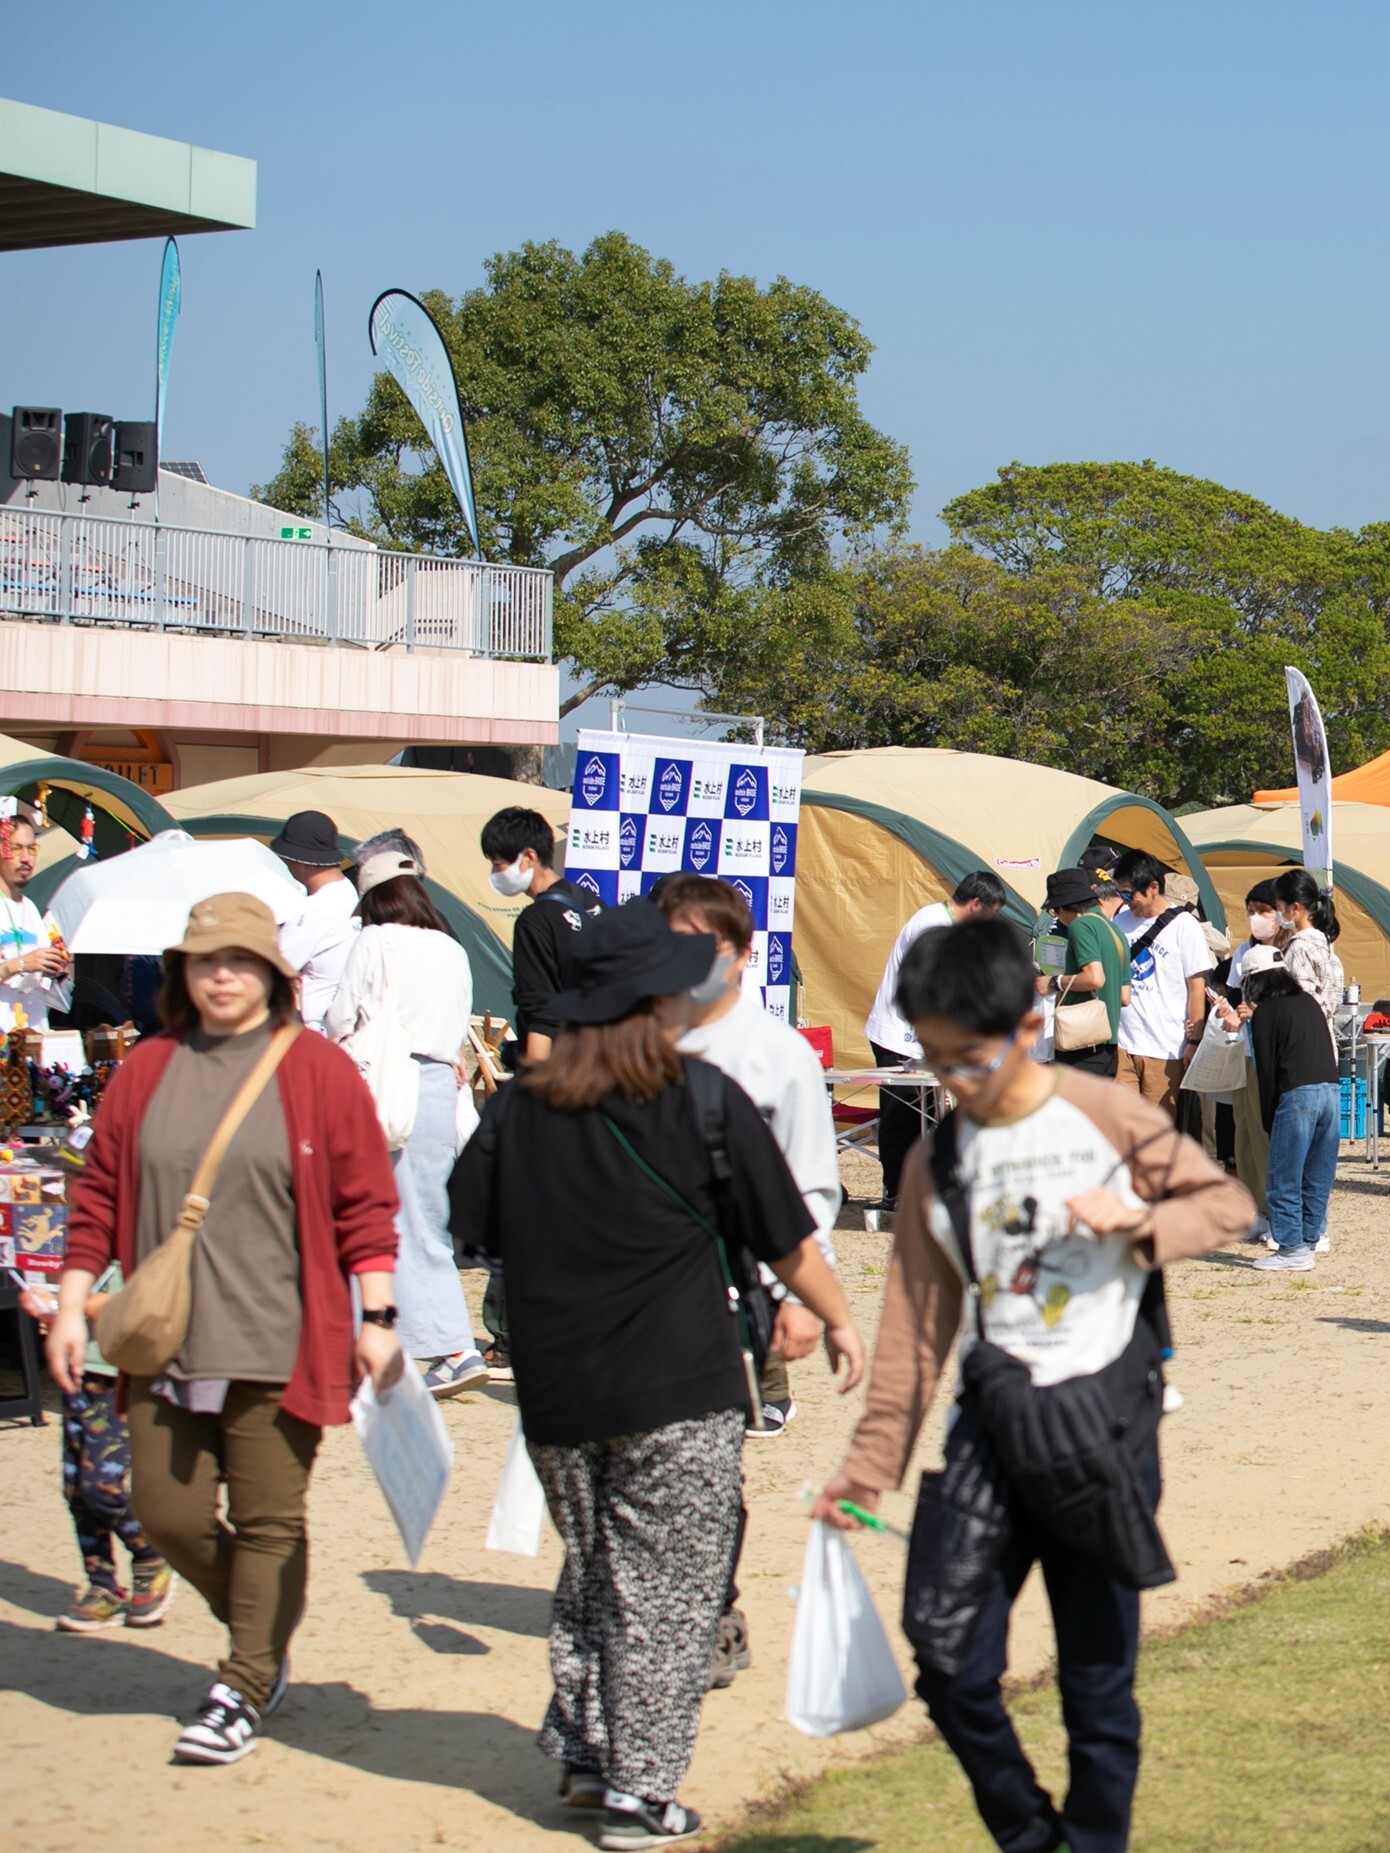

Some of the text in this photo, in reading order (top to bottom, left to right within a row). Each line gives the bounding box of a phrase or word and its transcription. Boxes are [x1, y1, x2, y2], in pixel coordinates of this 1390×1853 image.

[584, 829, 610, 845] 水上村
[659, 834, 679, 849] 水上村
[736, 839, 762, 853] 水上村
